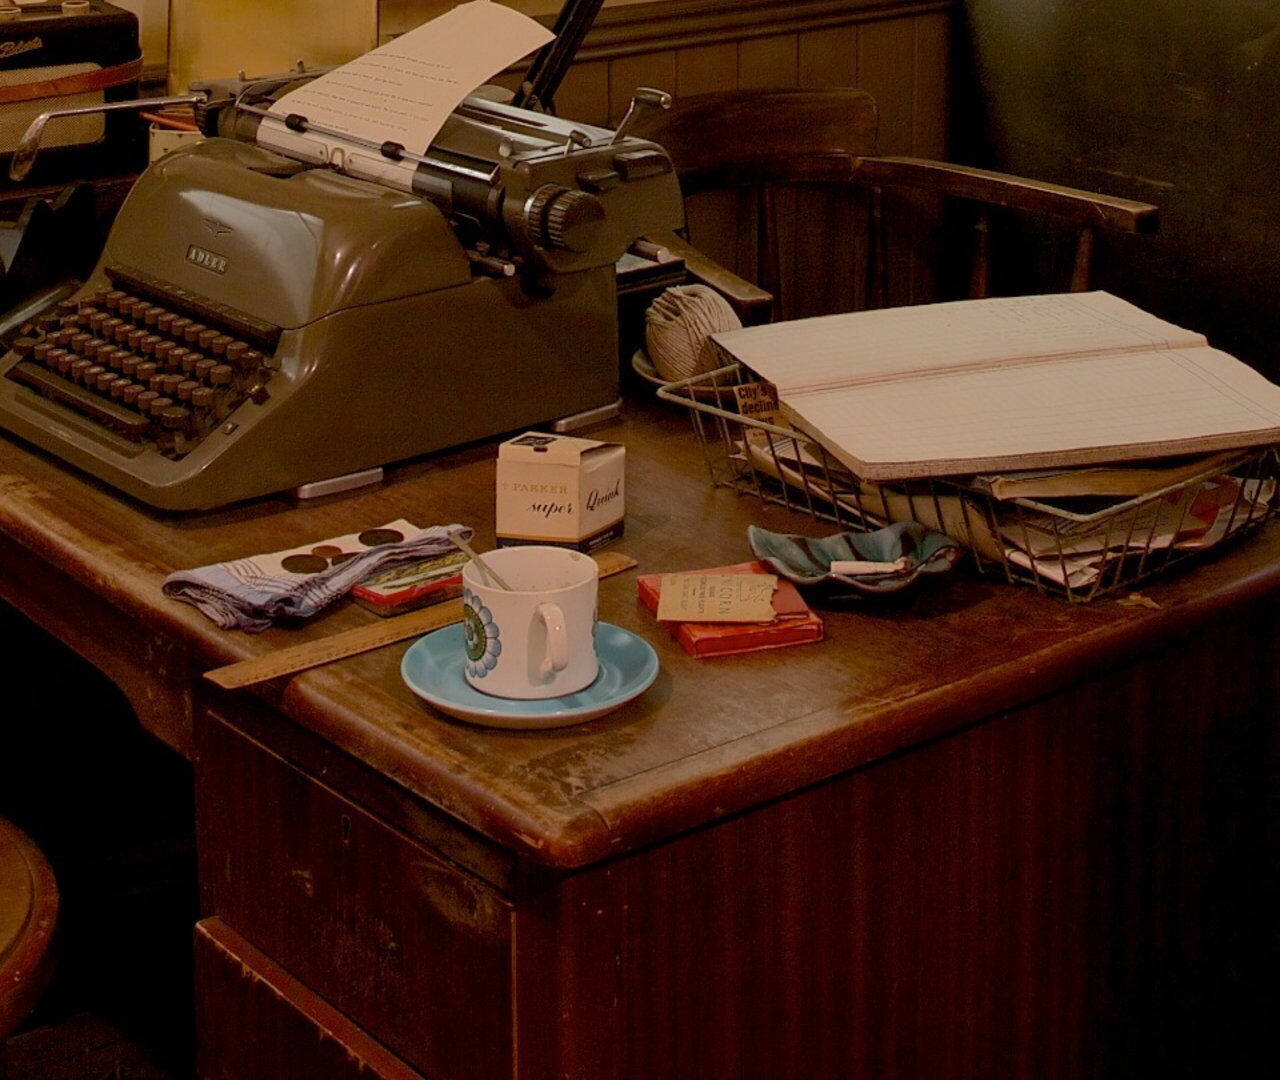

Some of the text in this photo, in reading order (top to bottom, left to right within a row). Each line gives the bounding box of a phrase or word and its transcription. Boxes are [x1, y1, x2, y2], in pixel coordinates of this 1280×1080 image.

[189, 249, 228, 273] ADLER
[512, 483, 568, 494] PARKER
[586, 479, 620, 511] Quink
[528, 502, 572, 518] super
